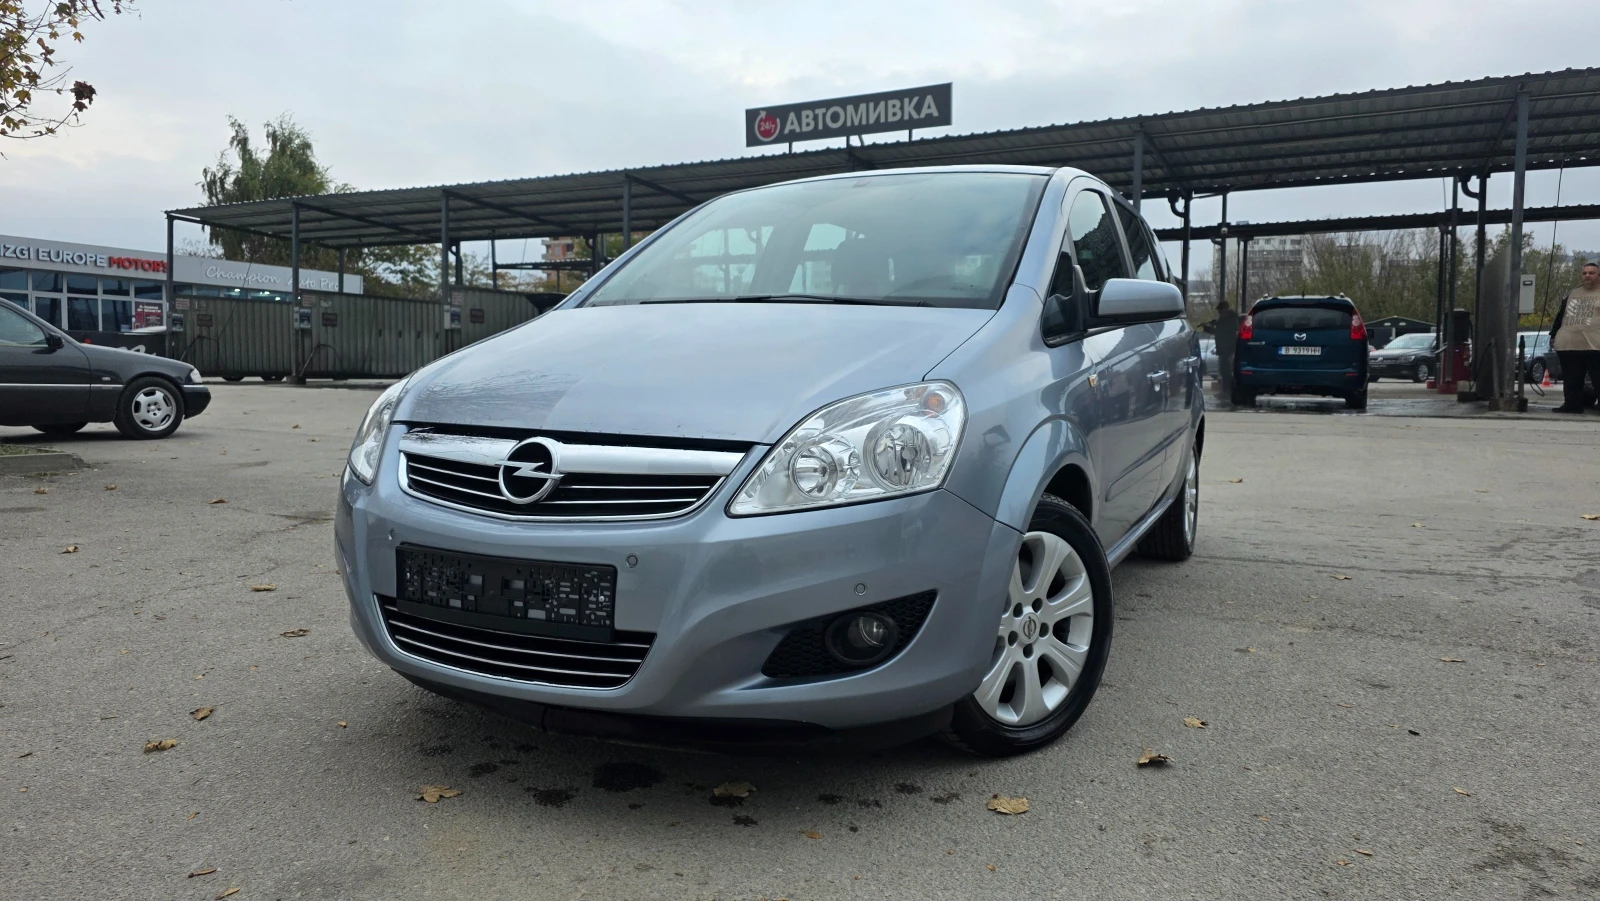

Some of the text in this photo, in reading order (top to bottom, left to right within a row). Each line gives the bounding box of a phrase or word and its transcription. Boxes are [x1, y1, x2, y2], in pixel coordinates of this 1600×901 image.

[783, 94, 939, 134] АВТОМИВКА
[760, 121, 775, 133] 24/7
[38, 247, 107, 267] EUROPE
[205, 265, 280, 285] Champion
